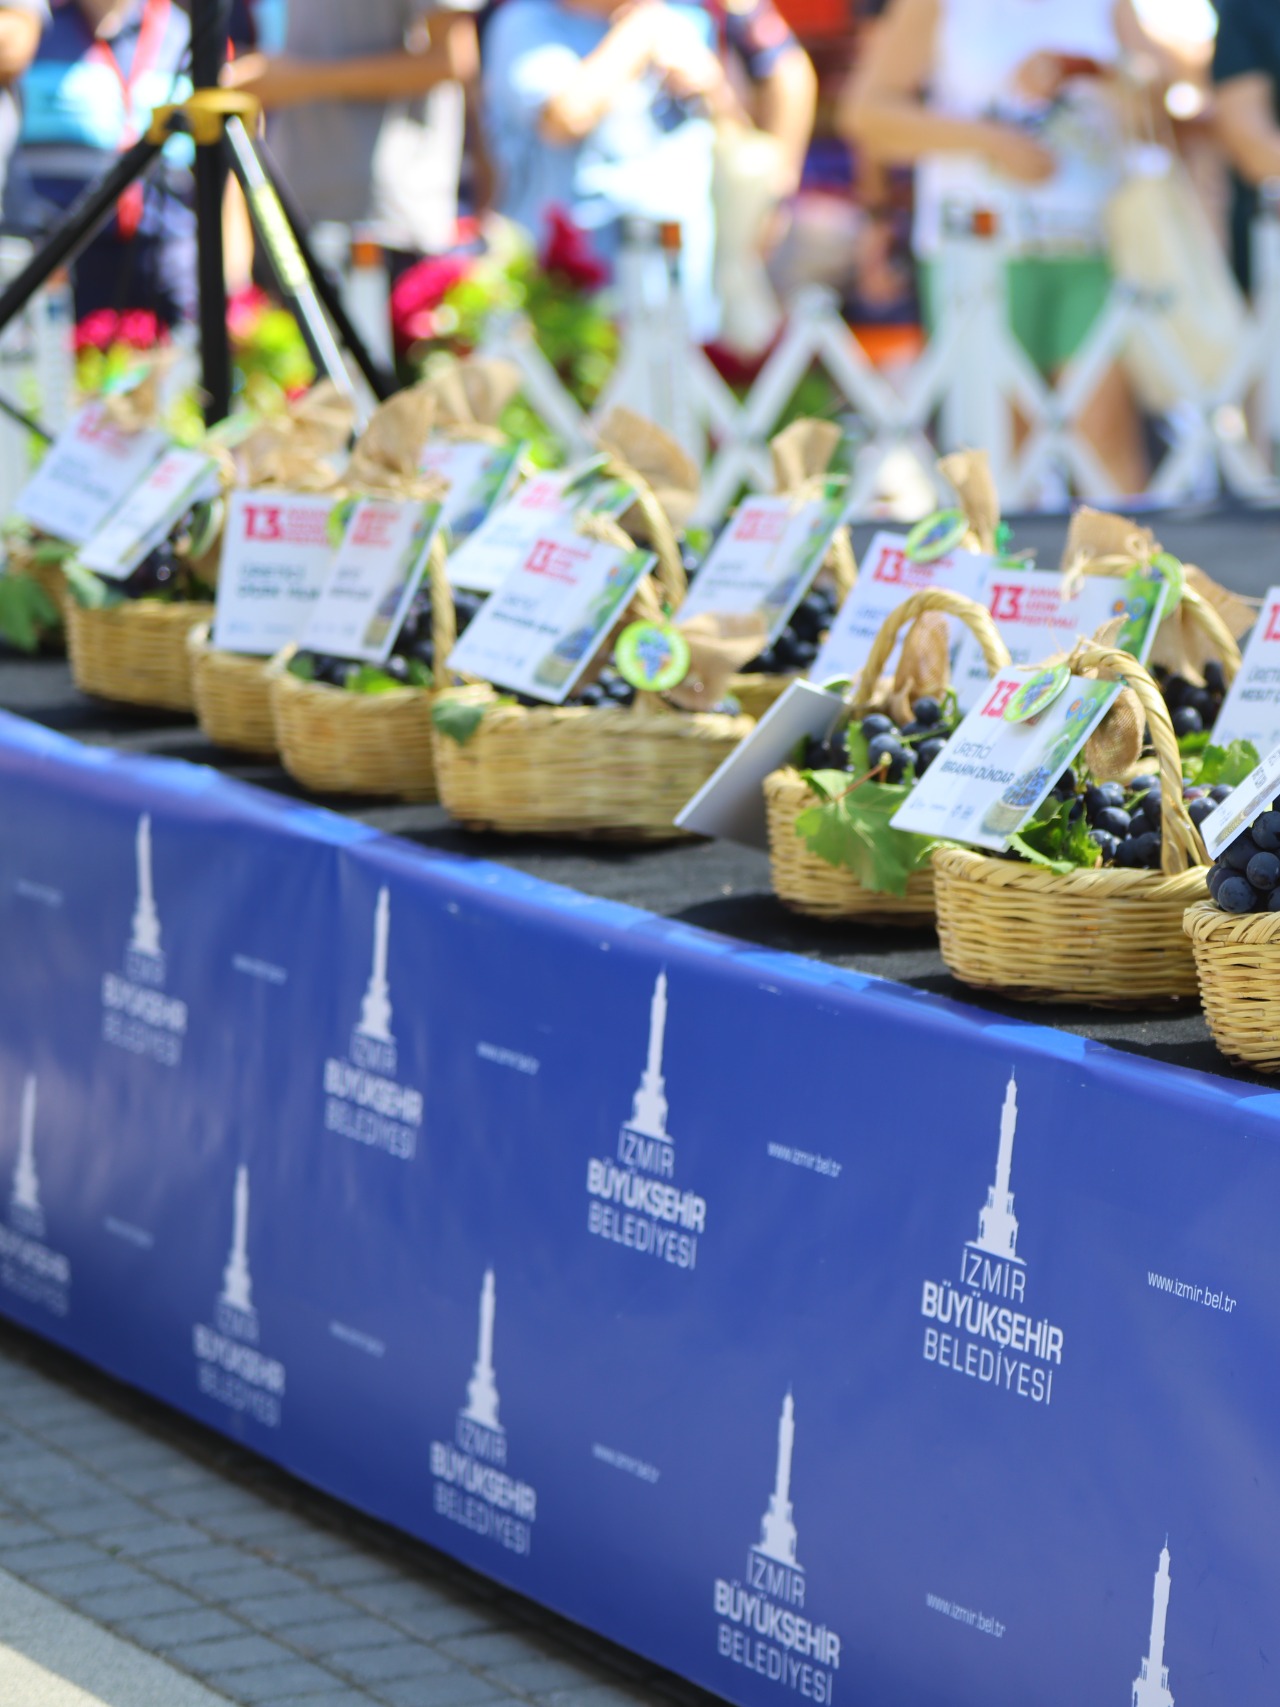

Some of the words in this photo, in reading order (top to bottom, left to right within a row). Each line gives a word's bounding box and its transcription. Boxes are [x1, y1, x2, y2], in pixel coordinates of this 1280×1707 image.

[617, 1127, 675, 1179] İZMİR
[587, 1156, 706, 1234] BÜYÜKŞEHİR
[588, 1200, 698, 1271] BELEDİYESİ
[960, 1247, 1027, 1305] İZMİR
[1147, 1270, 1238, 1314] www.izmir.bel.tr
[921, 1279, 1065, 1366] BÜYÜKŞEHİR
[922, 1326, 1054, 1406] BELEDİYESİ
[746, 1549, 807, 1608] İZMİR
[714, 1577, 841, 1670] BÜYÜKŞEHİR
[718, 1623, 834, 1707] BELEDİYESİ
